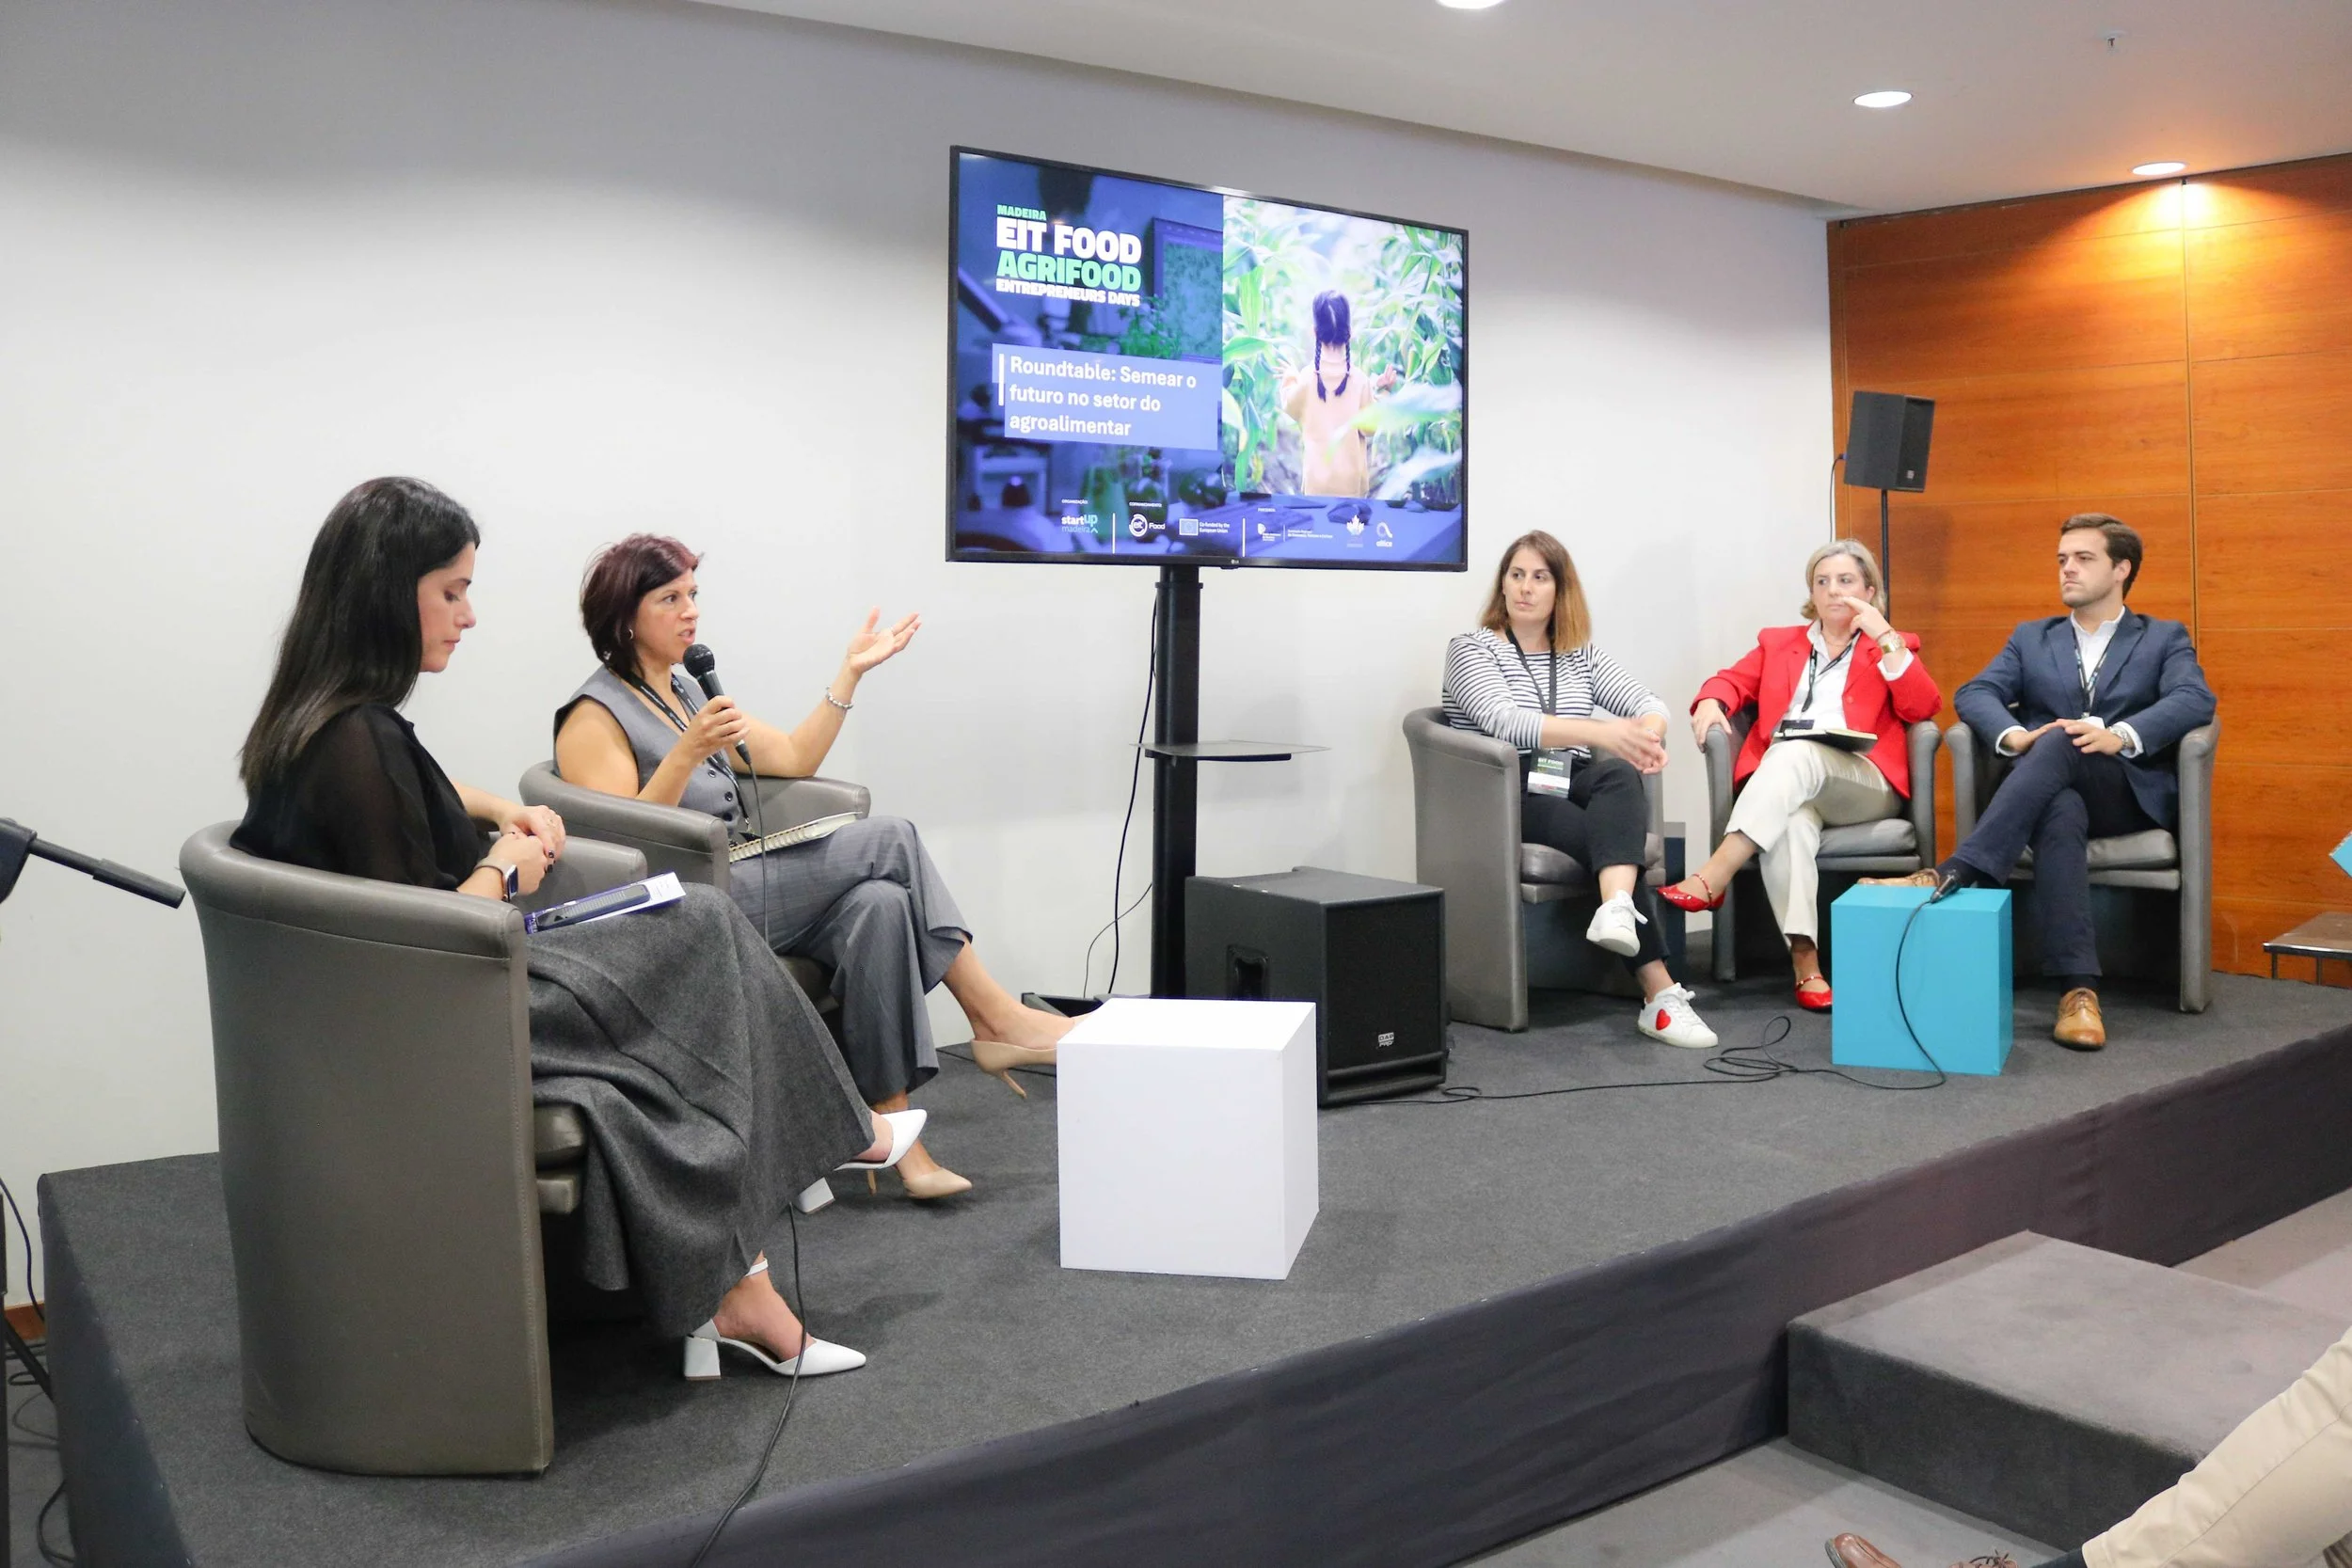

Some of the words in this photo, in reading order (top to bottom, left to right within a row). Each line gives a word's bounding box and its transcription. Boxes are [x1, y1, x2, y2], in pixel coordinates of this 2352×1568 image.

[997, 204, 1047, 220] MADEIRA
[996, 216, 1047, 252] EIT
[1054, 224, 1142, 264] FOOD
[996, 250, 1142, 292] AGRIFOOD
[996, 278, 1106, 303] ENTREPRENEURS
[1108, 291, 1140, 307] DAYS
[1010, 356, 1116, 381] Roundtable:
[1120, 366, 1183, 388] Semear
[1186, 375, 1197, 388] o
[1009, 384, 1063, 404] futuro
[1068, 391, 1089, 405] no
[1093, 393, 1136, 410] setor
[1140, 395, 1161, 411] do
[1009, 415, 1132, 436] agroalimentar
